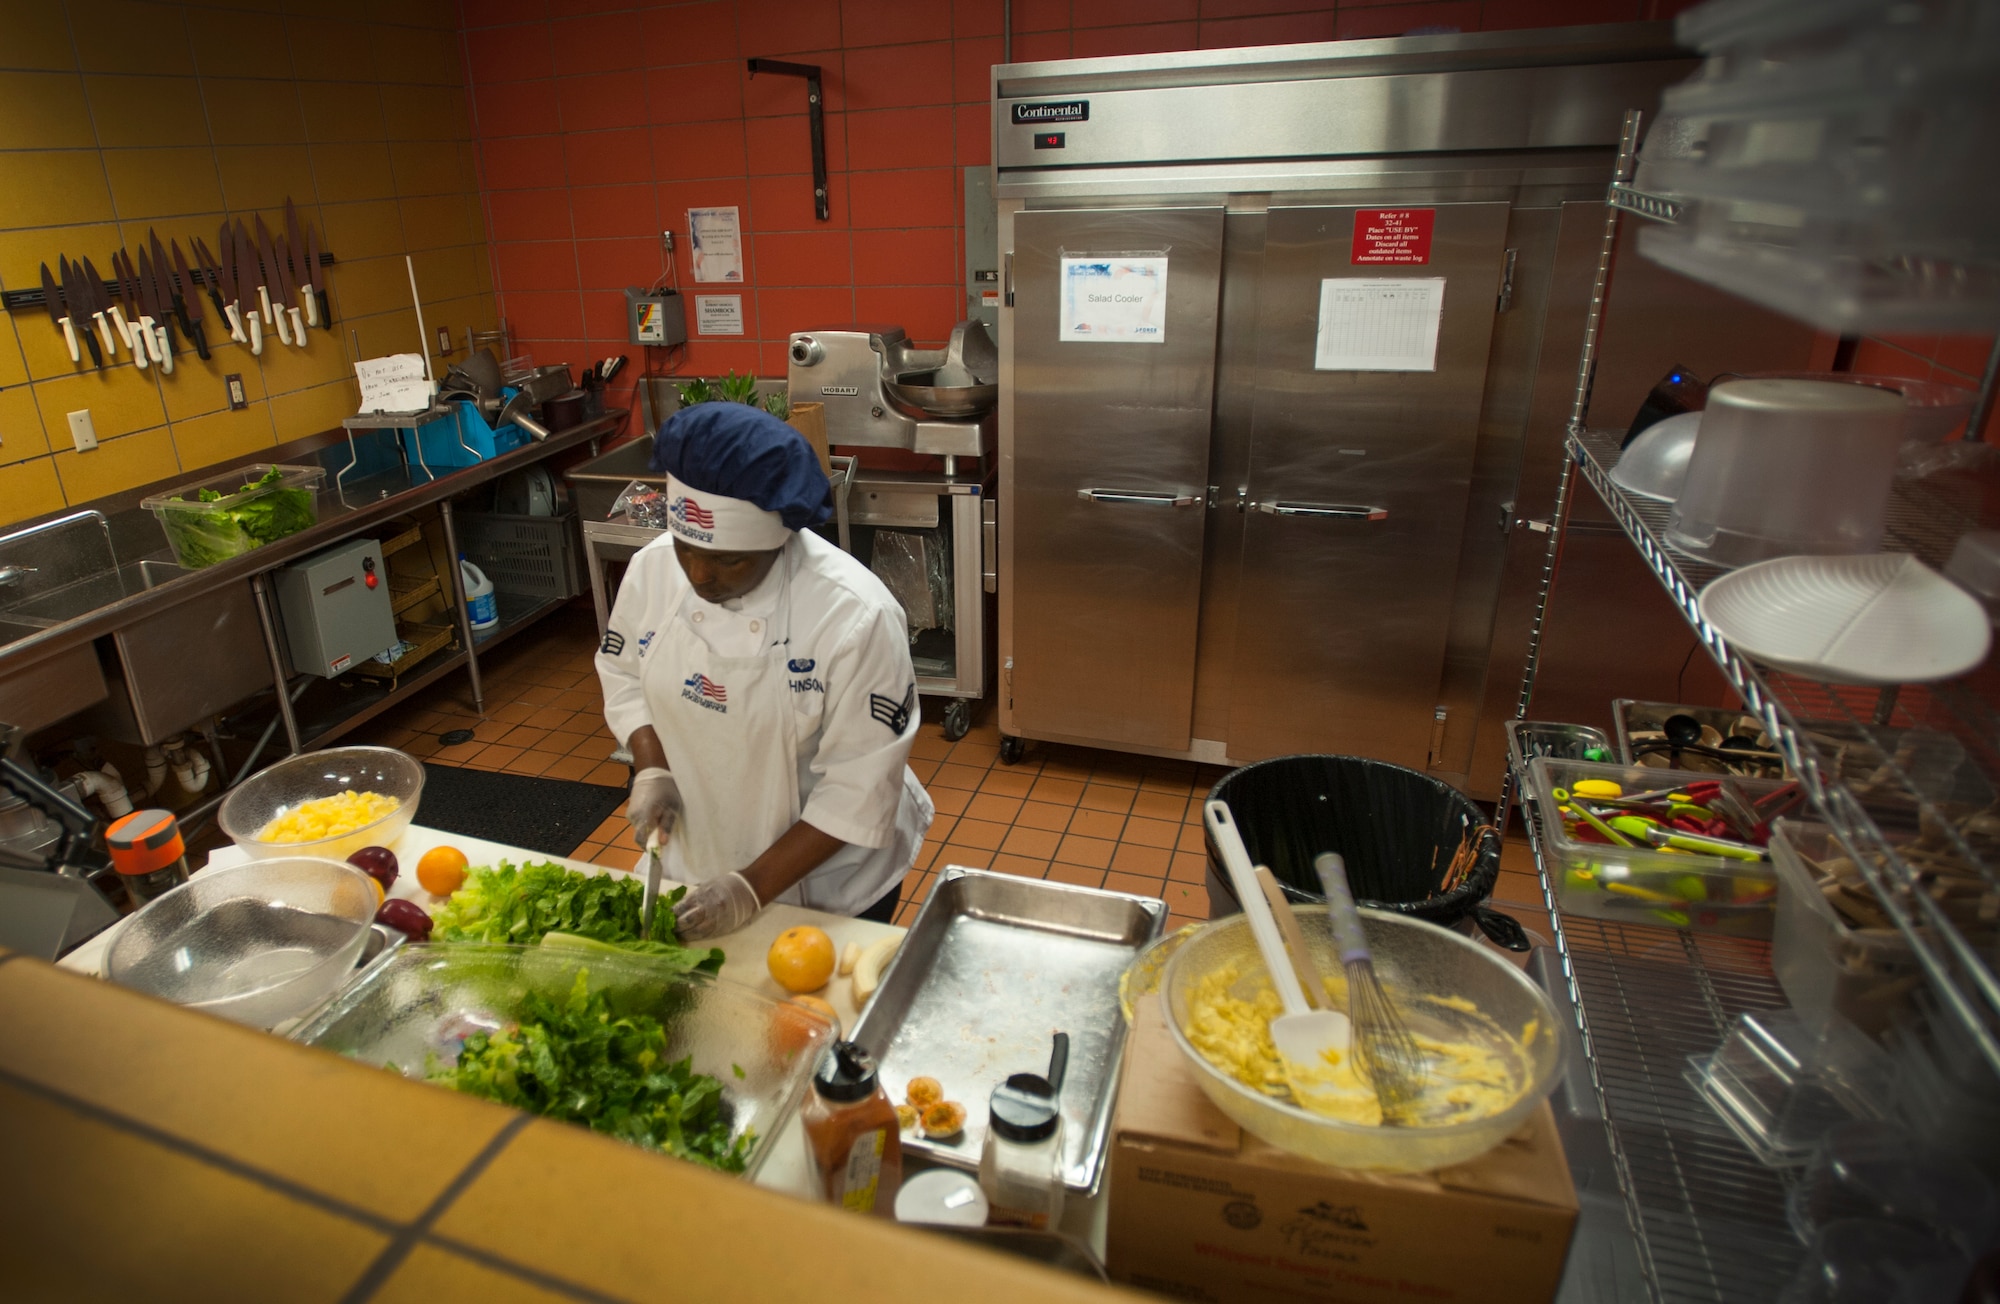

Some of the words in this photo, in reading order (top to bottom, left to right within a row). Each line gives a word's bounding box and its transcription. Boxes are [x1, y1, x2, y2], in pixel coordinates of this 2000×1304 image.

[1018, 104, 1082, 118] Continental
[1047, 136, 1058, 144] 43
[1088, 294, 1112, 302] Salad
[1114, 294, 1143, 303] Cooler
